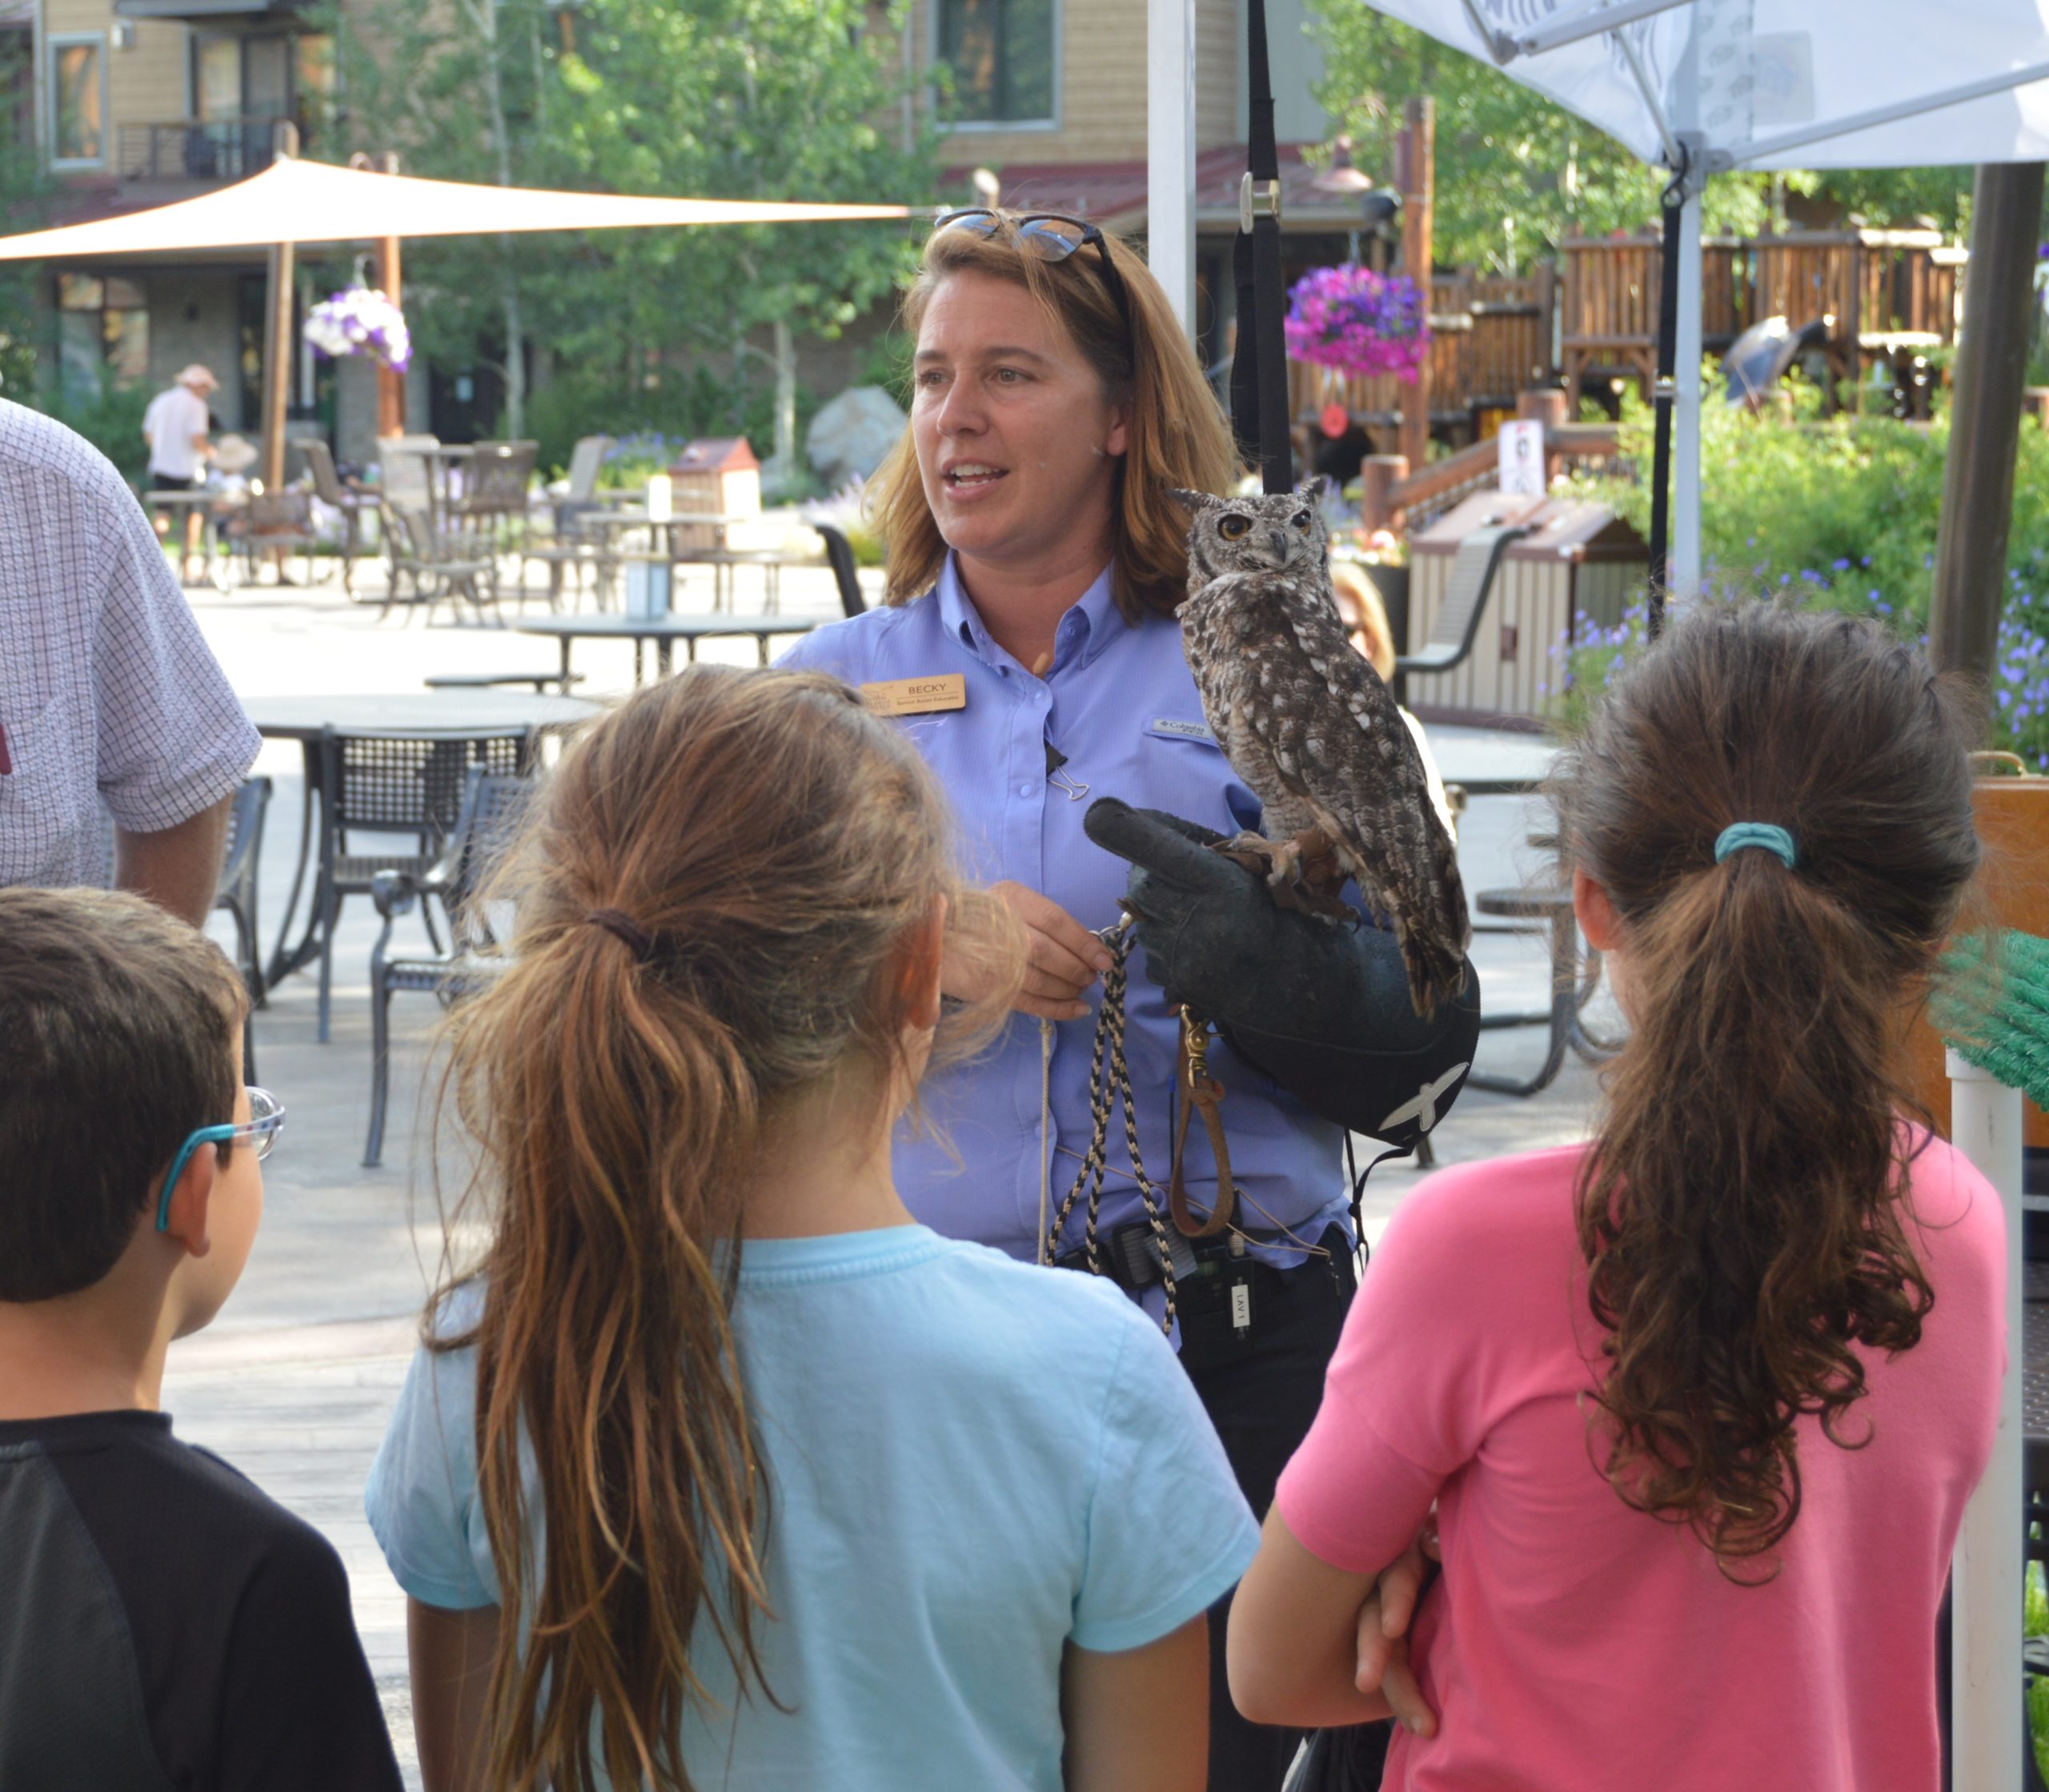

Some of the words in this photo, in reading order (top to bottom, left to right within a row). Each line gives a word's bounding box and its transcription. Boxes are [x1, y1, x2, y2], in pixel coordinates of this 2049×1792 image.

[908, 684, 947, 695] BECKY
[1169, 722, 1205, 732] Columbia
[1237, 1294, 1245, 1312] LAV
